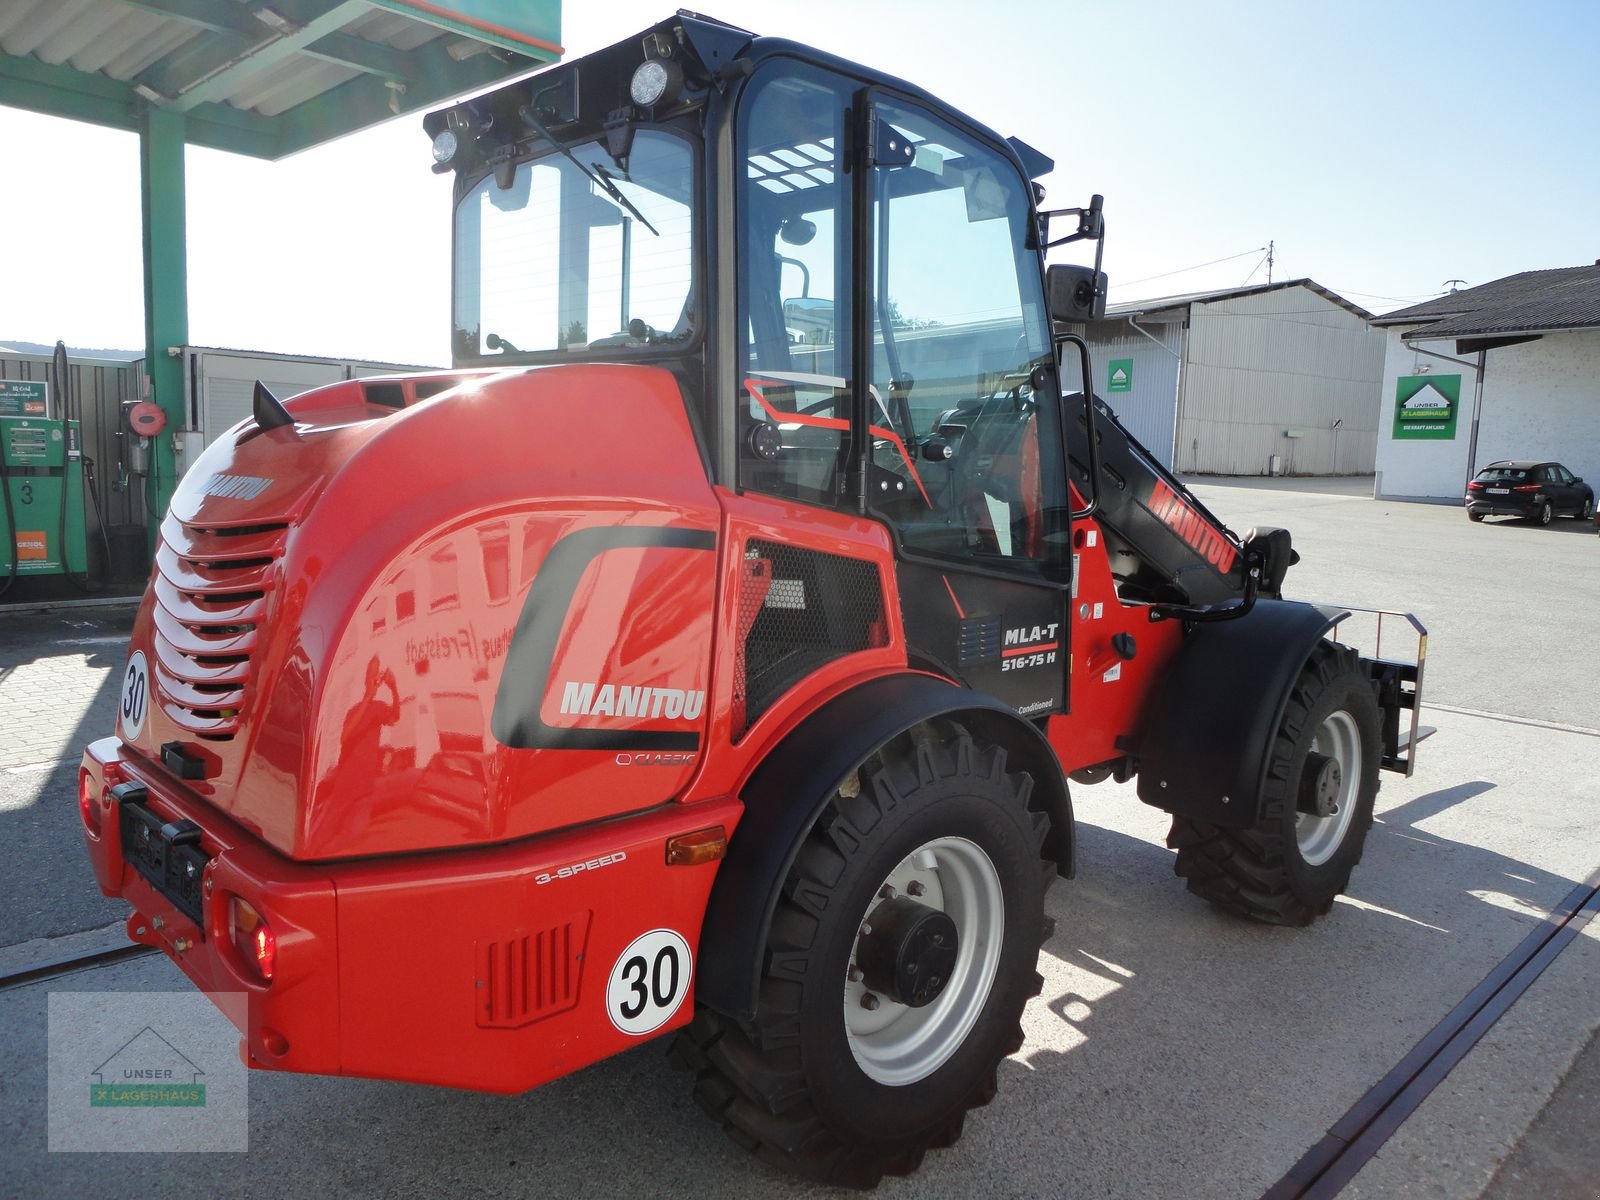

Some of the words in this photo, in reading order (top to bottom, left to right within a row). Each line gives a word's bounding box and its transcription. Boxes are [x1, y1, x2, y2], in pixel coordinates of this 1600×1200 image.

[21, 485, 34, 505] 3
[1147, 477, 1238, 575] MANITOU
[1004, 623, 1059, 646] MLA-T
[1001, 653, 1045, 672] 516-75
[1046, 651, 1056, 664] H
[123, 664, 145, 728] 30
[559, 681, 705, 721] MANITOU
[634, 753, 696, 767] CLASSIC
[534, 851, 627, 886] 3-SPEED
[619, 945, 680, 1020] 30
